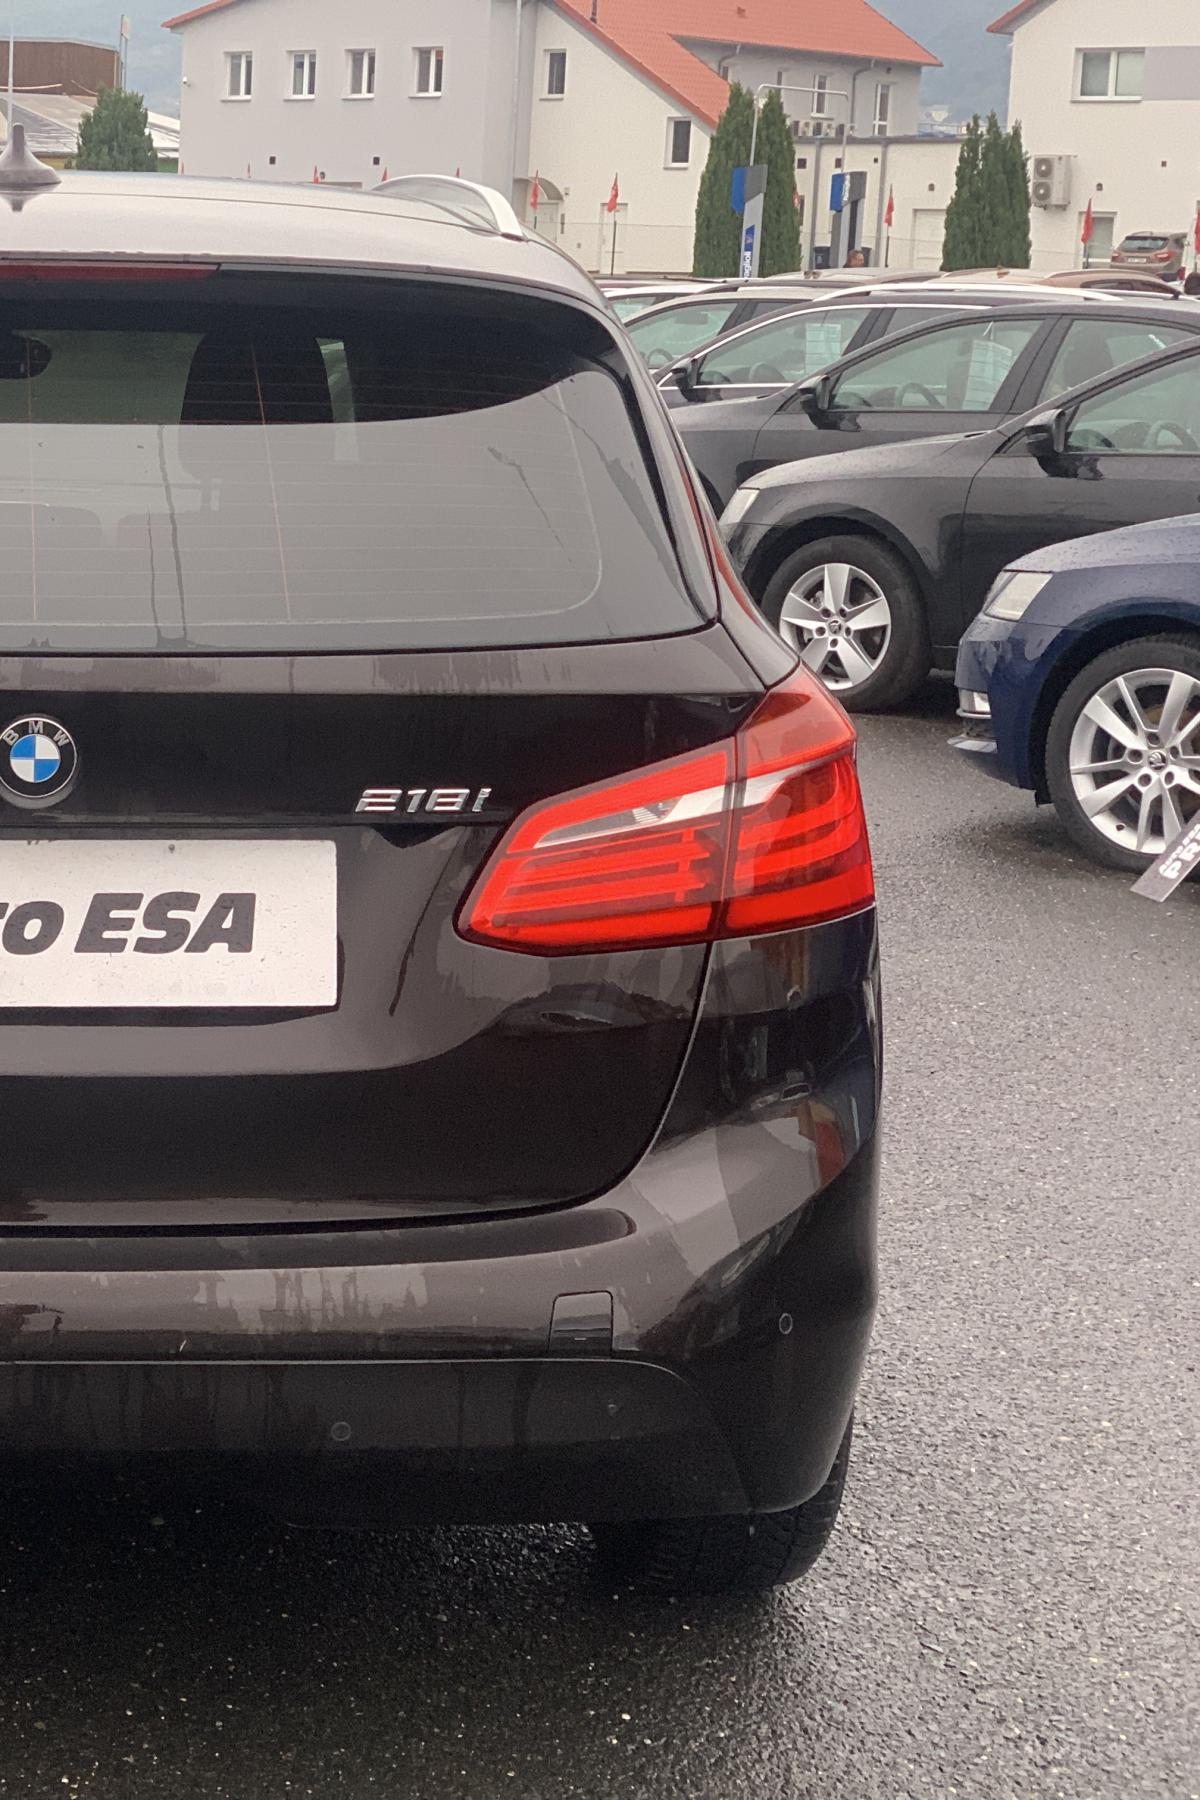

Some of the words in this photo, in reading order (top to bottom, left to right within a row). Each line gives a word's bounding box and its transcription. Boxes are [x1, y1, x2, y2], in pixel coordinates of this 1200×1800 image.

[2, 720, 69, 747] BMW
[355, 788, 492, 813] 218i
[74, 891, 256, 954] ESA
